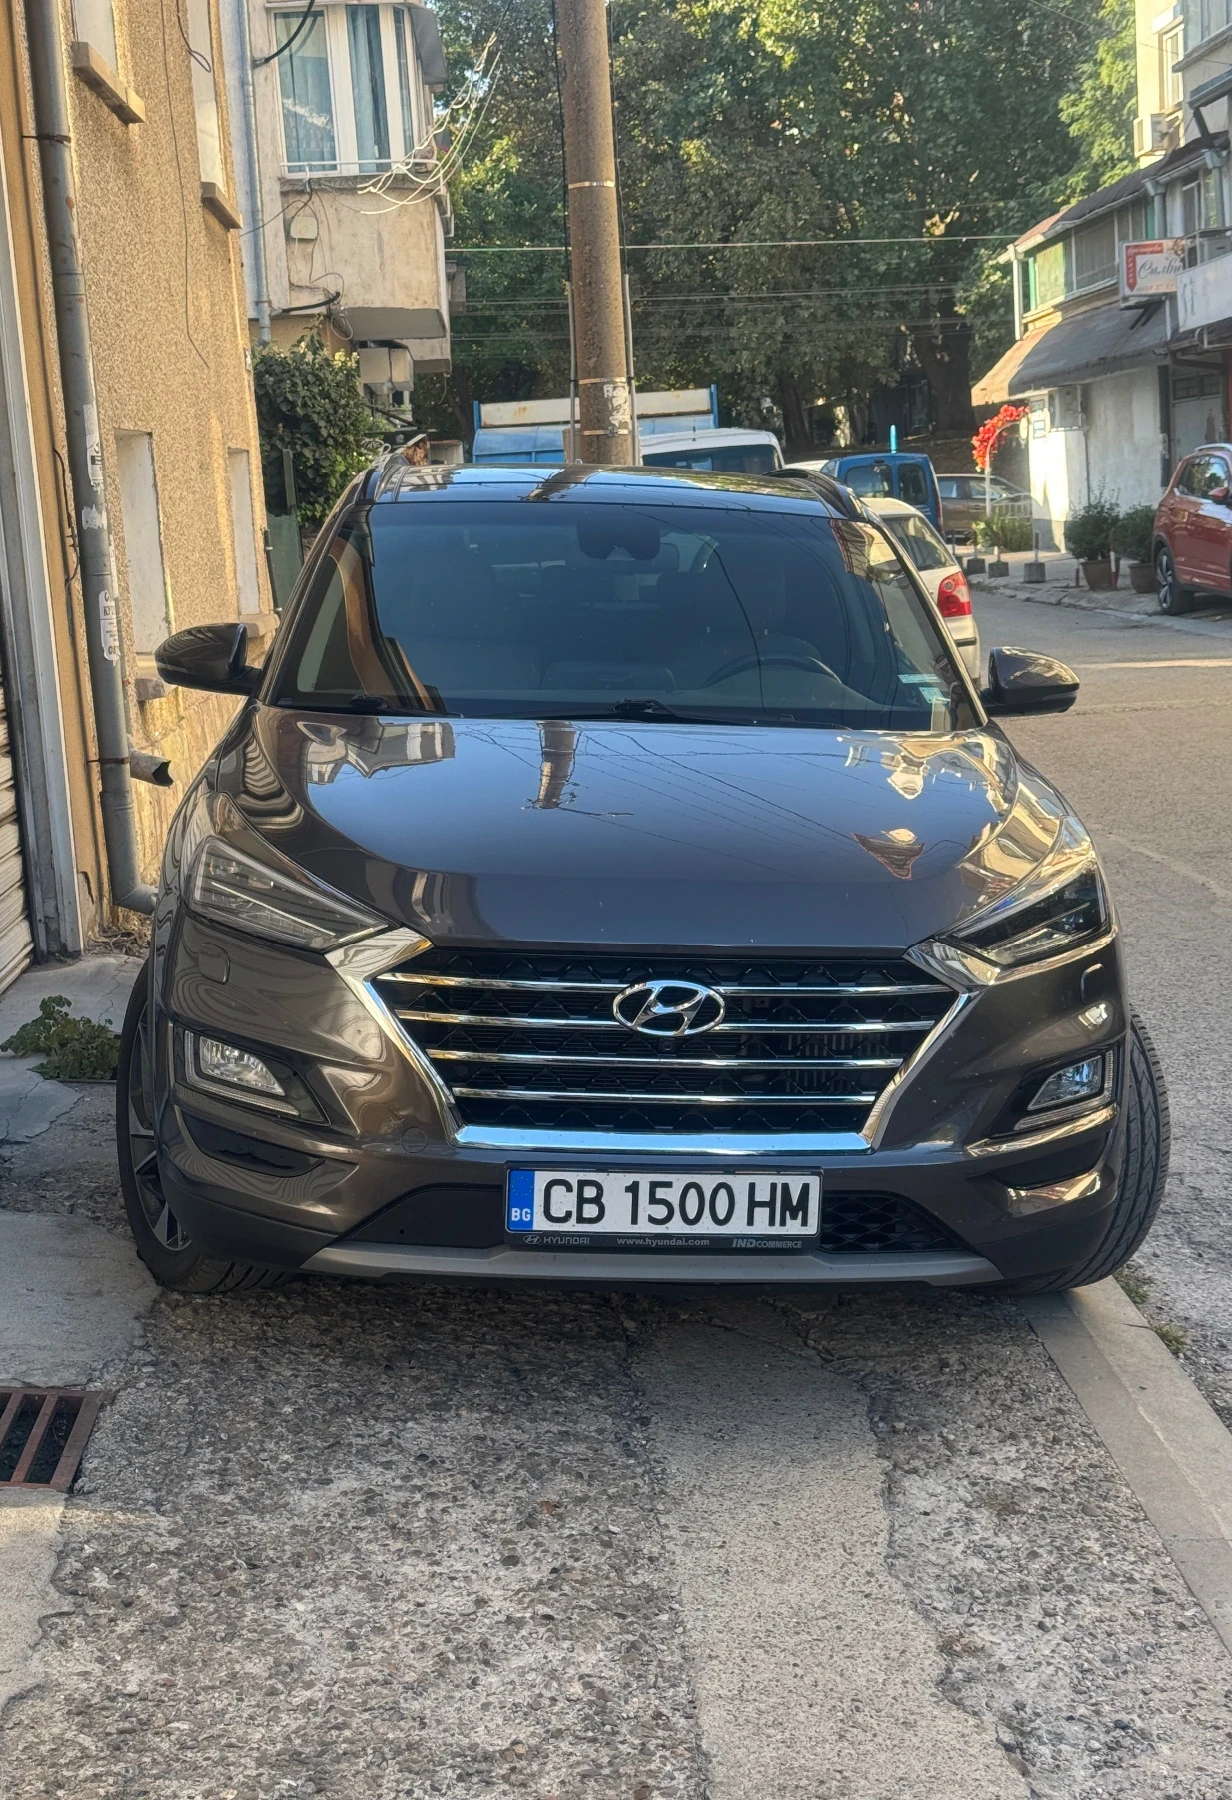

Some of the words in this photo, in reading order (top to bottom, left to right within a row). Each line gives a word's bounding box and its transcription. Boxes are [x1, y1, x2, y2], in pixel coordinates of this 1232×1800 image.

[542, 1178, 606, 1225] CB
[624, 1180, 736, 1227] 1500
[746, 1182, 811, 1227] HM
[511, 1207, 531, 1222] BG
[543, 1236, 590, 1245] HYUNDAI
[616, 1237, 710, 1247] www.hyundai.com
